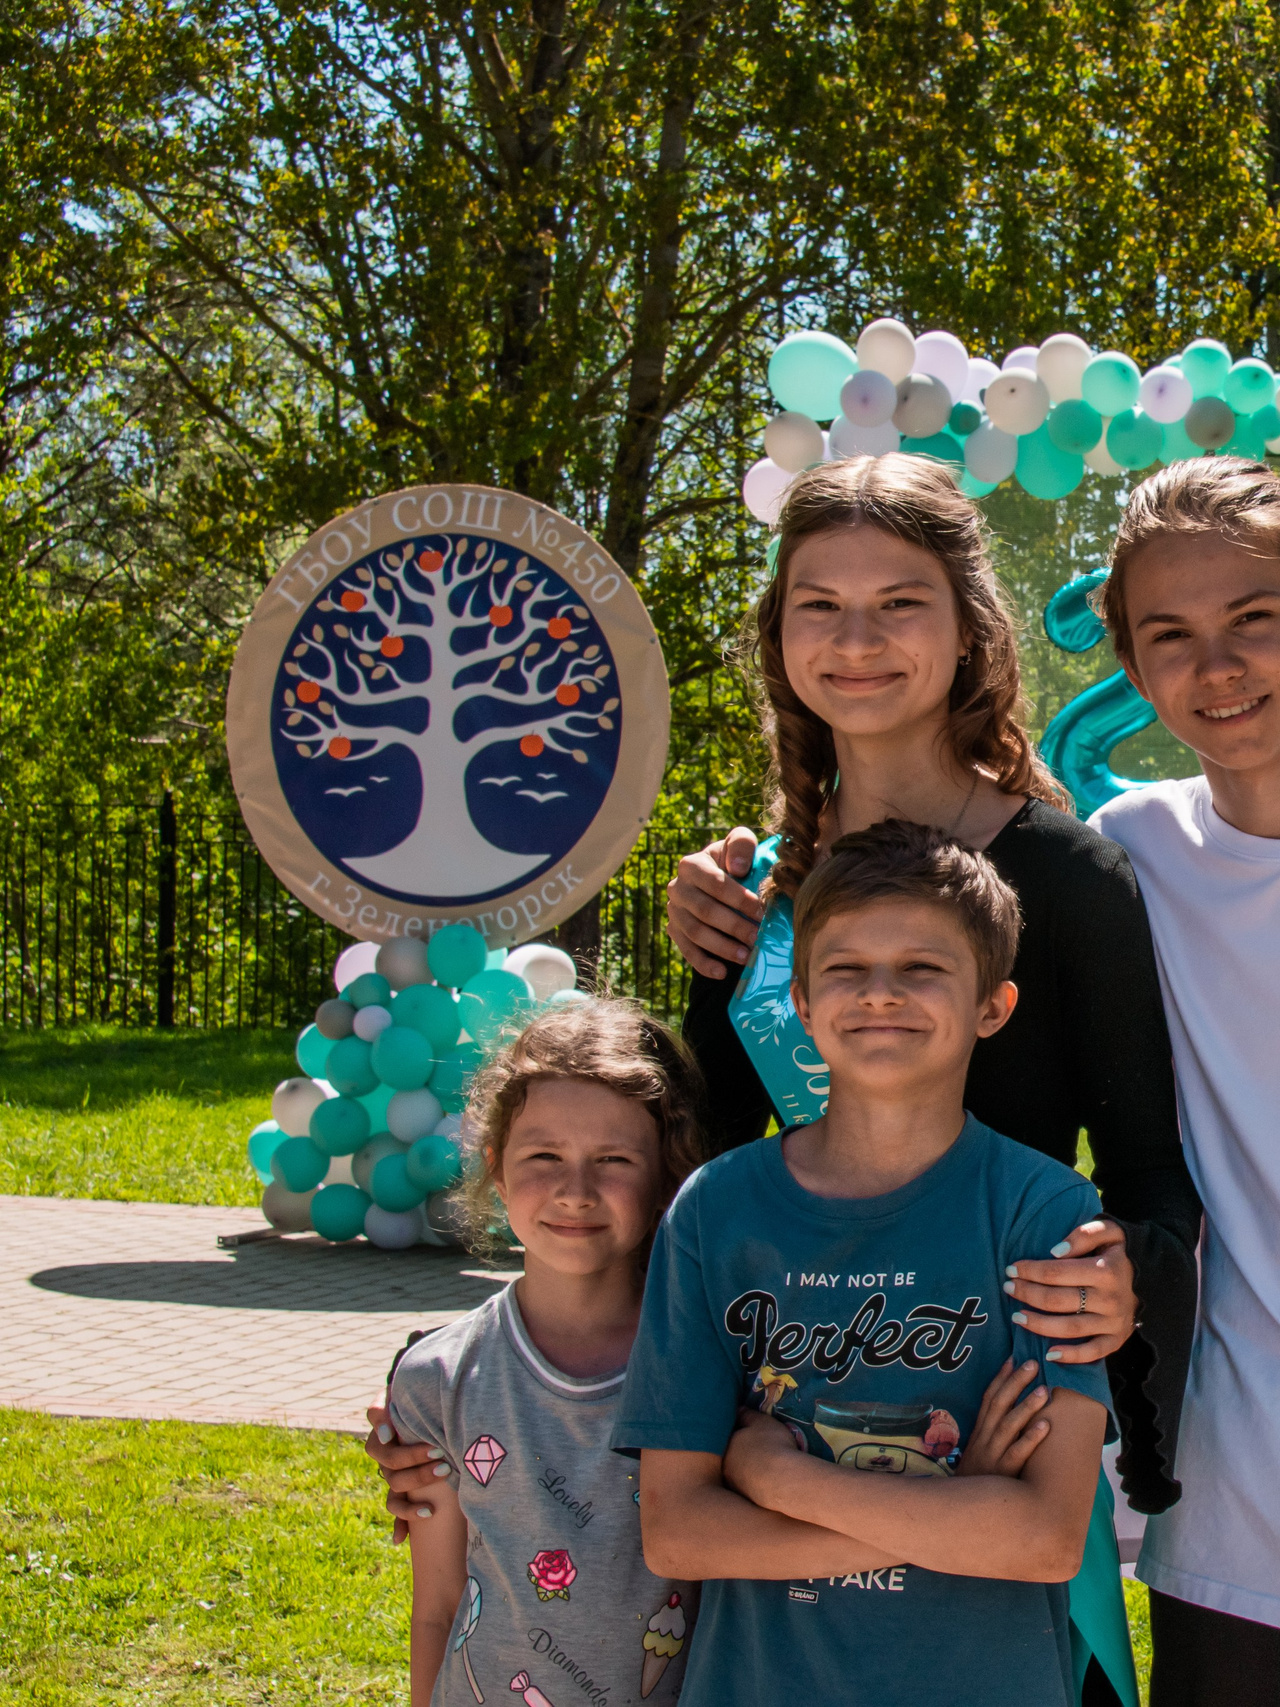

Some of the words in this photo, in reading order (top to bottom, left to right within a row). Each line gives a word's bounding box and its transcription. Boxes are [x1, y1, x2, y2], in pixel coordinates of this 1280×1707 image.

[274, 508, 373, 612] ГБОУ
[392, 491, 508, 533] СОШ
[512, 507, 621, 604] №450
[786, 1272, 792, 1286] I
[800, 1272, 841, 1287] MAY
[847, 1272, 888, 1288] NOT
[894, 1271, 916, 1286] BE
[725, 1290, 988, 1383] Perfect
[537, 1467, 596, 1529] Lovely
